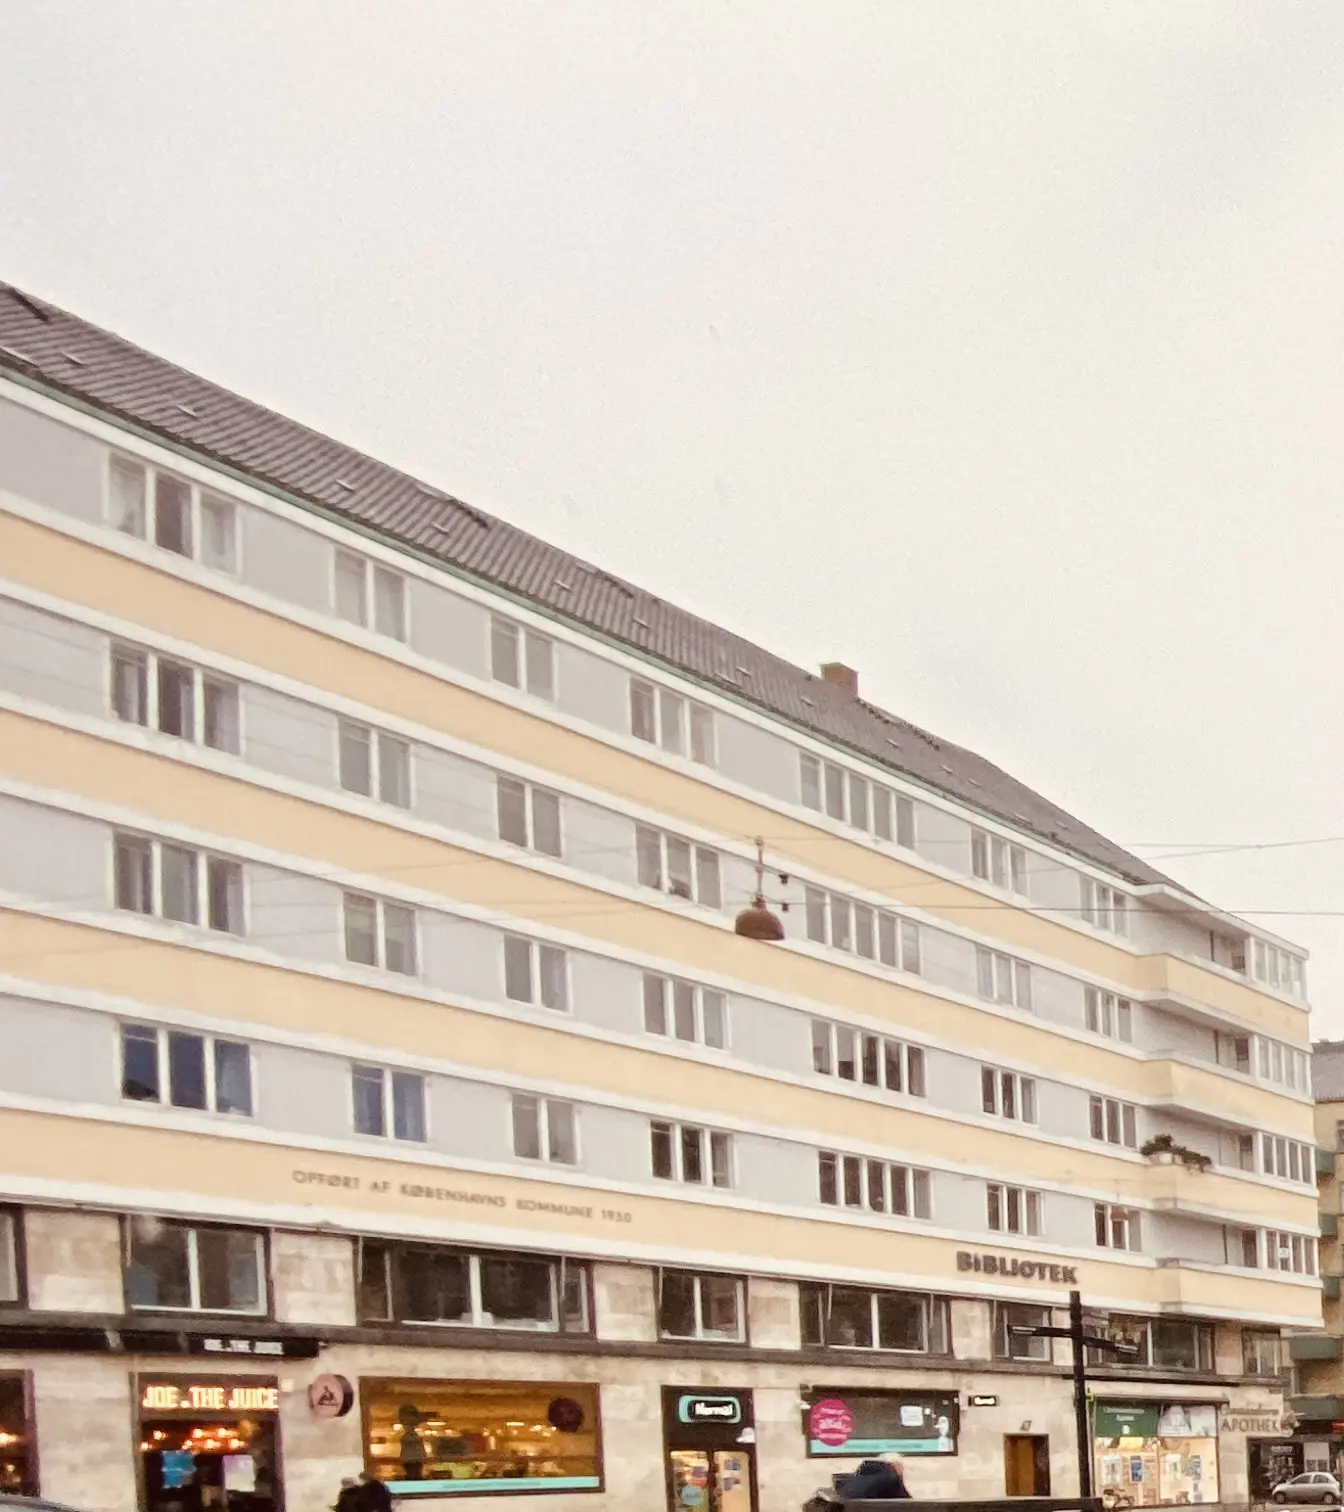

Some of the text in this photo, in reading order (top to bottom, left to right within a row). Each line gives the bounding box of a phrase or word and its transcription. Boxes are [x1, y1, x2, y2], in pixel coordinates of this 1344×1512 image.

[369, 1180, 392, 1193] AF
[516, 1198, 594, 1220] KOMMUNE
[956, 1250, 1078, 1285] BIBLIOTEK
[189, 1387, 225, 1409] THE
[228, 1388, 279, 1410] JUICE
